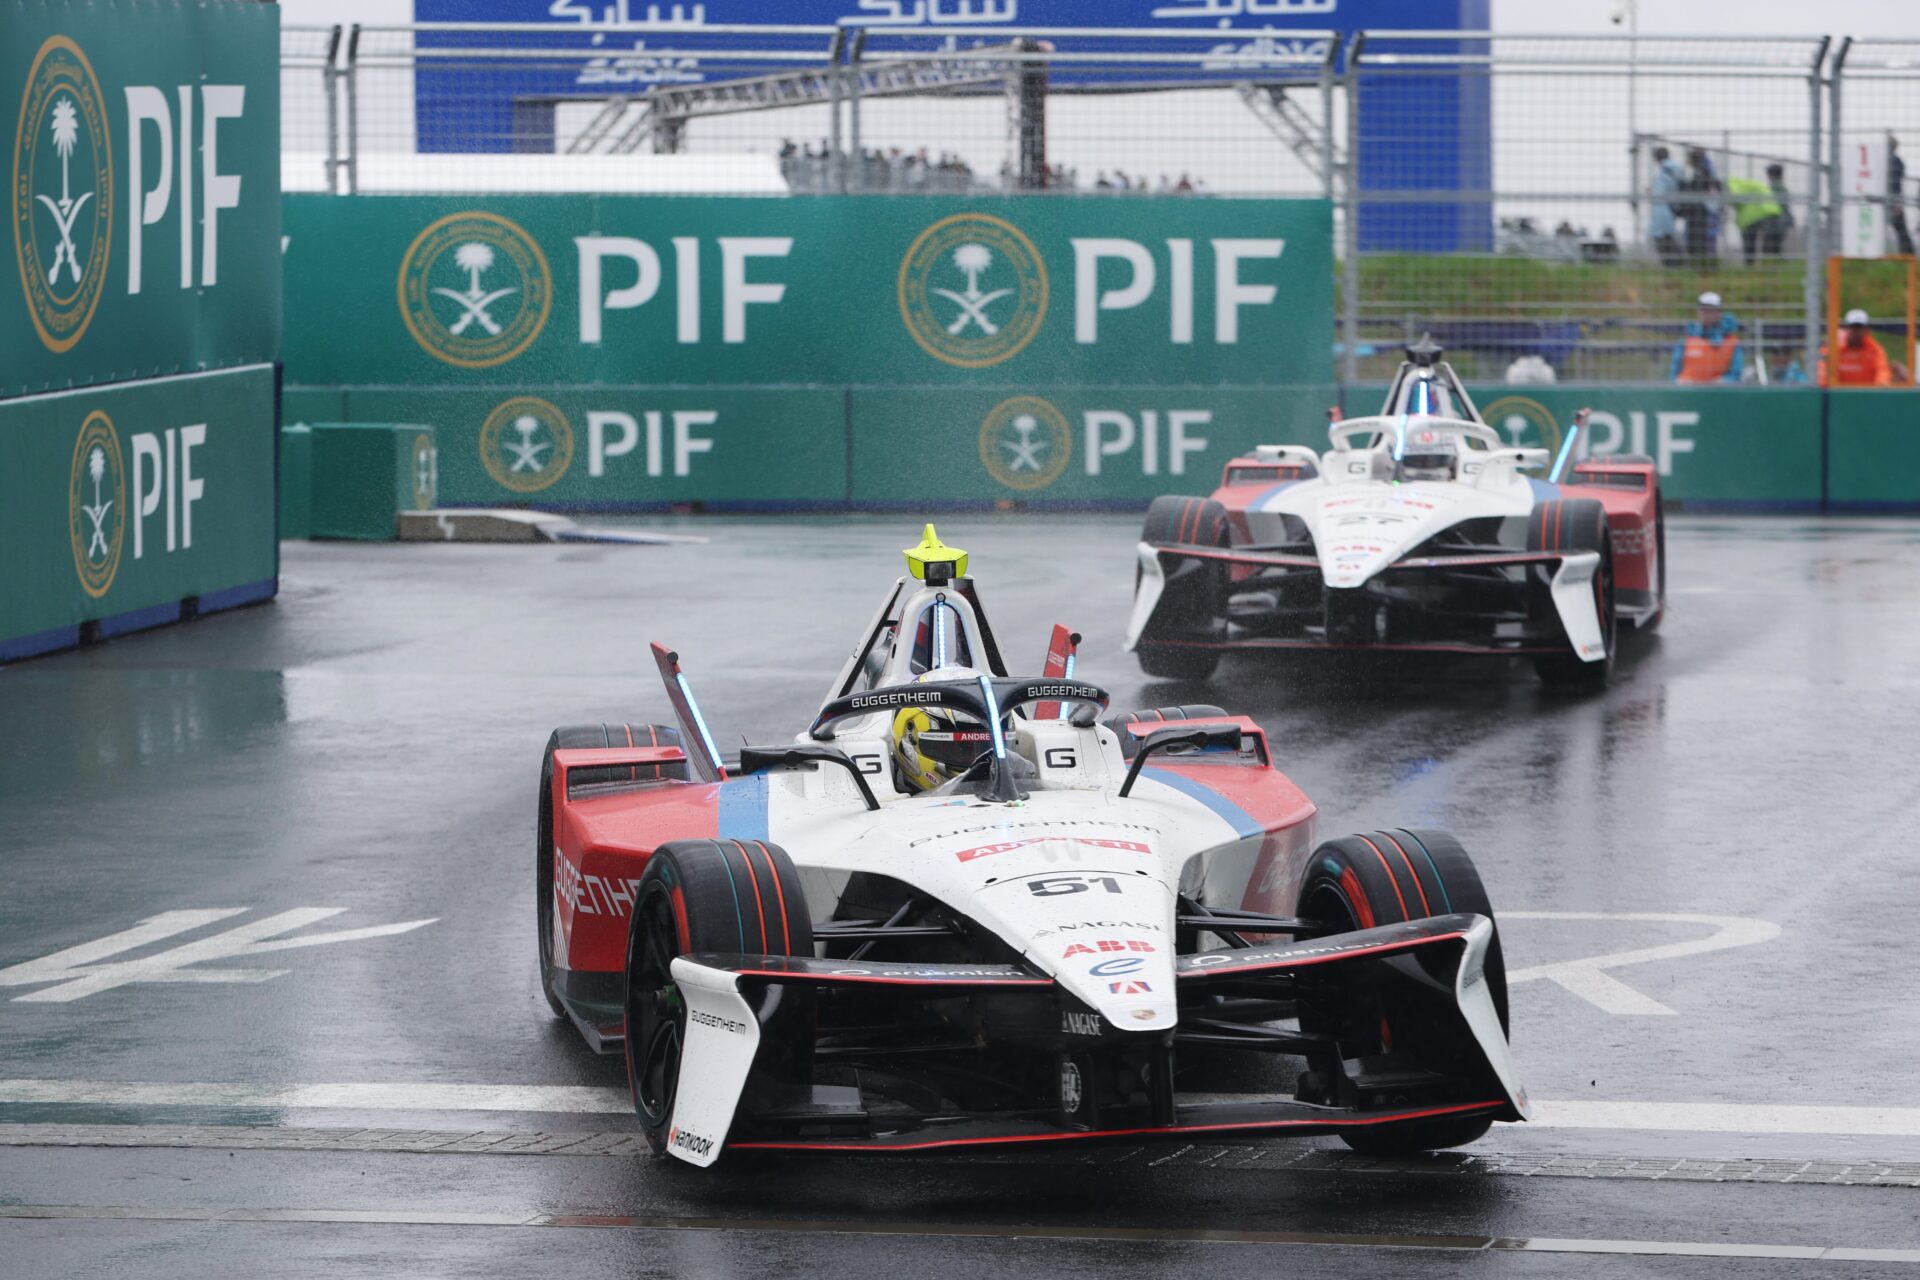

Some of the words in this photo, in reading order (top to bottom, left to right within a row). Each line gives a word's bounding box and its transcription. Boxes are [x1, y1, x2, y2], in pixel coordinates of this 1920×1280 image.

[124, 85, 246, 294] PIF
[573, 236, 795, 343] PIF
[1070, 238, 1286, 344] PIF
[586, 411, 718, 477] PIF
[1083, 410, 1213, 475] PIF
[1576, 411, 1700, 476] PIF
[131, 423, 207, 559] PIF
[851, 691, 942, 709] GUGGENHEIM
[1027, 685, 1099, 699] GUGGENHEIM
[961, 732, 991, 741] ANDRE
[852, 753, 882, 775] G
[1045, 748, 1077, 769] G
[555, 846, 641, 917] GUGGENH
[1027, 876, 1123, 897] 51
[1062, 940, 1156, 959] ABB
[691, 1009, 746, 1035] GUGGENHEIM
[1067, 1011, 1102, 1036] NAGASE
